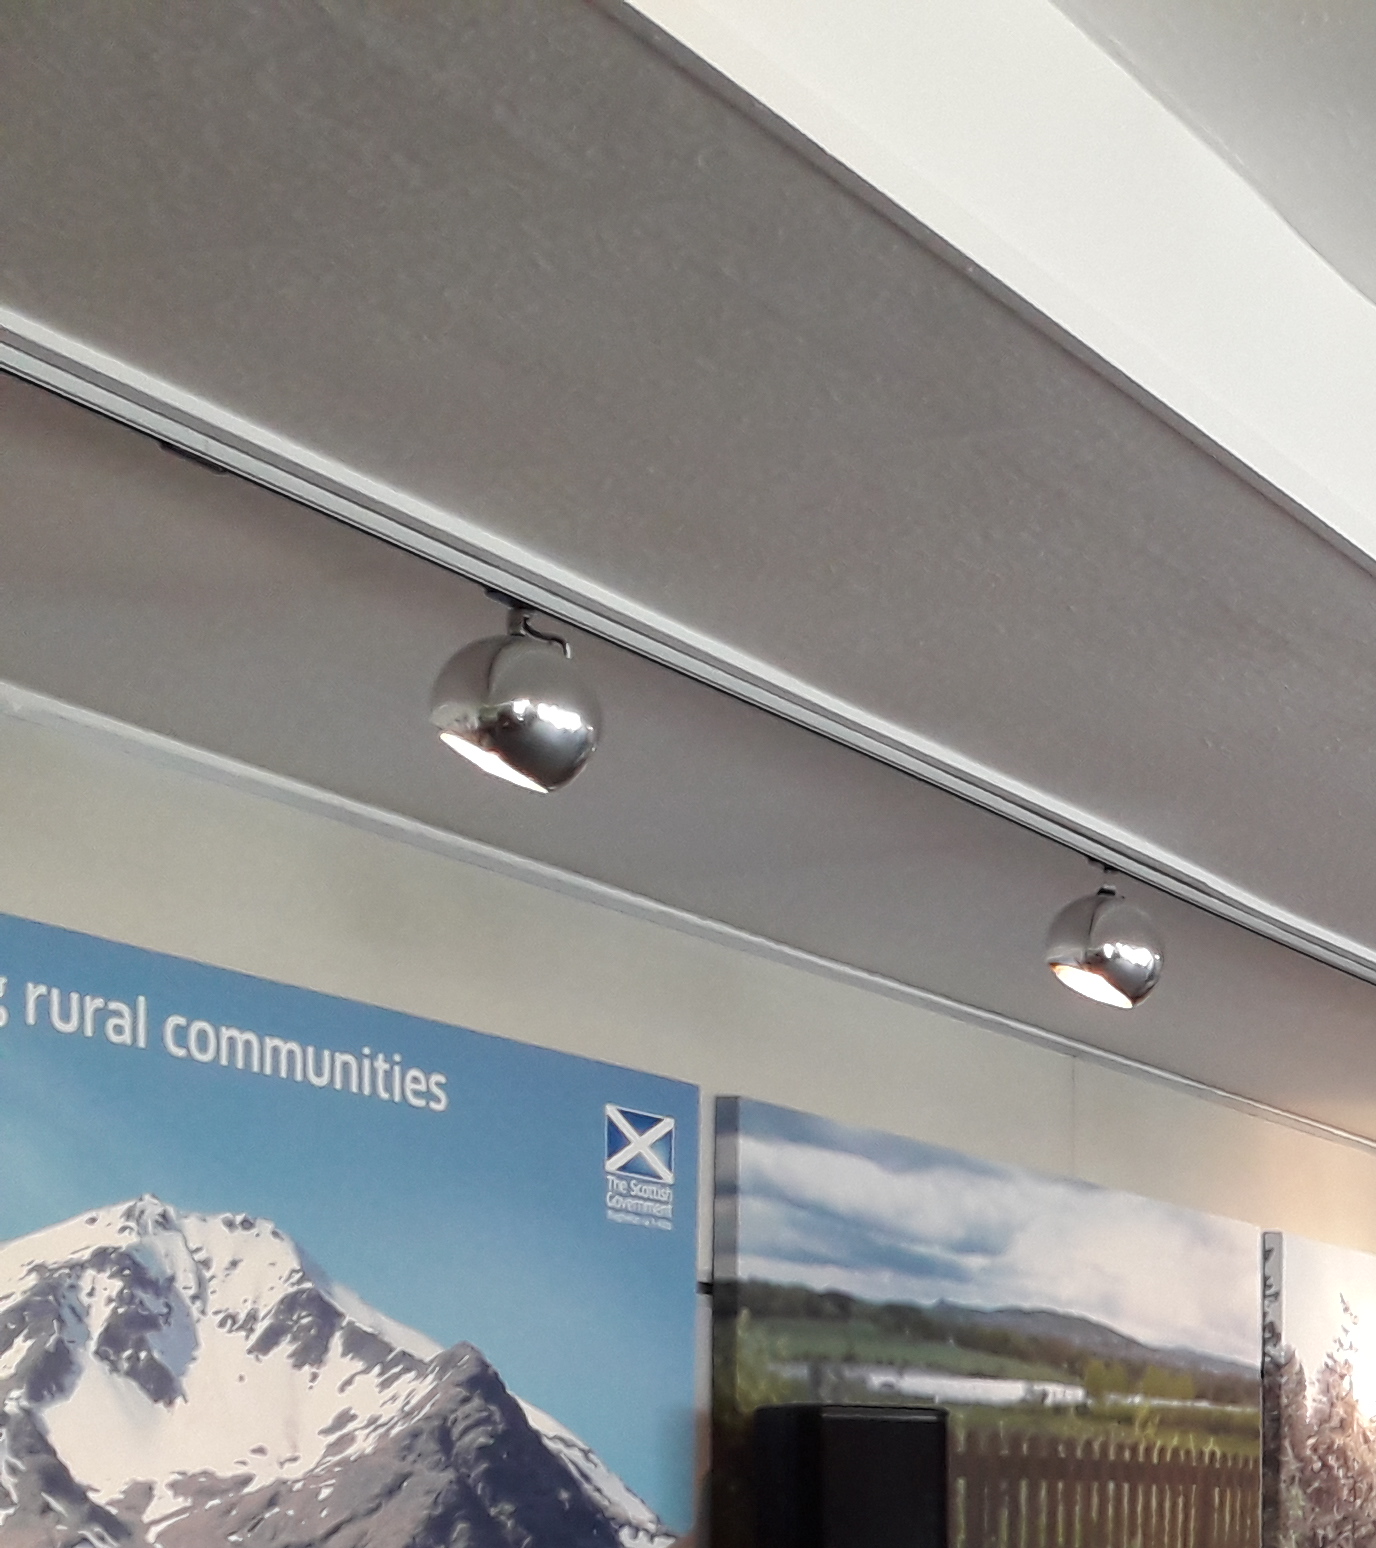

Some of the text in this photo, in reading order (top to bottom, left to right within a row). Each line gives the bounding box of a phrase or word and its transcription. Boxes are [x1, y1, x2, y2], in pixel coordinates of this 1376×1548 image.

[25, 981, 147, 1049] rural
[163, 1013, 449, 1113] communities
[606, 1175, 673, 1202] The Scottish
[606, 1192, 673, 1218] Government
